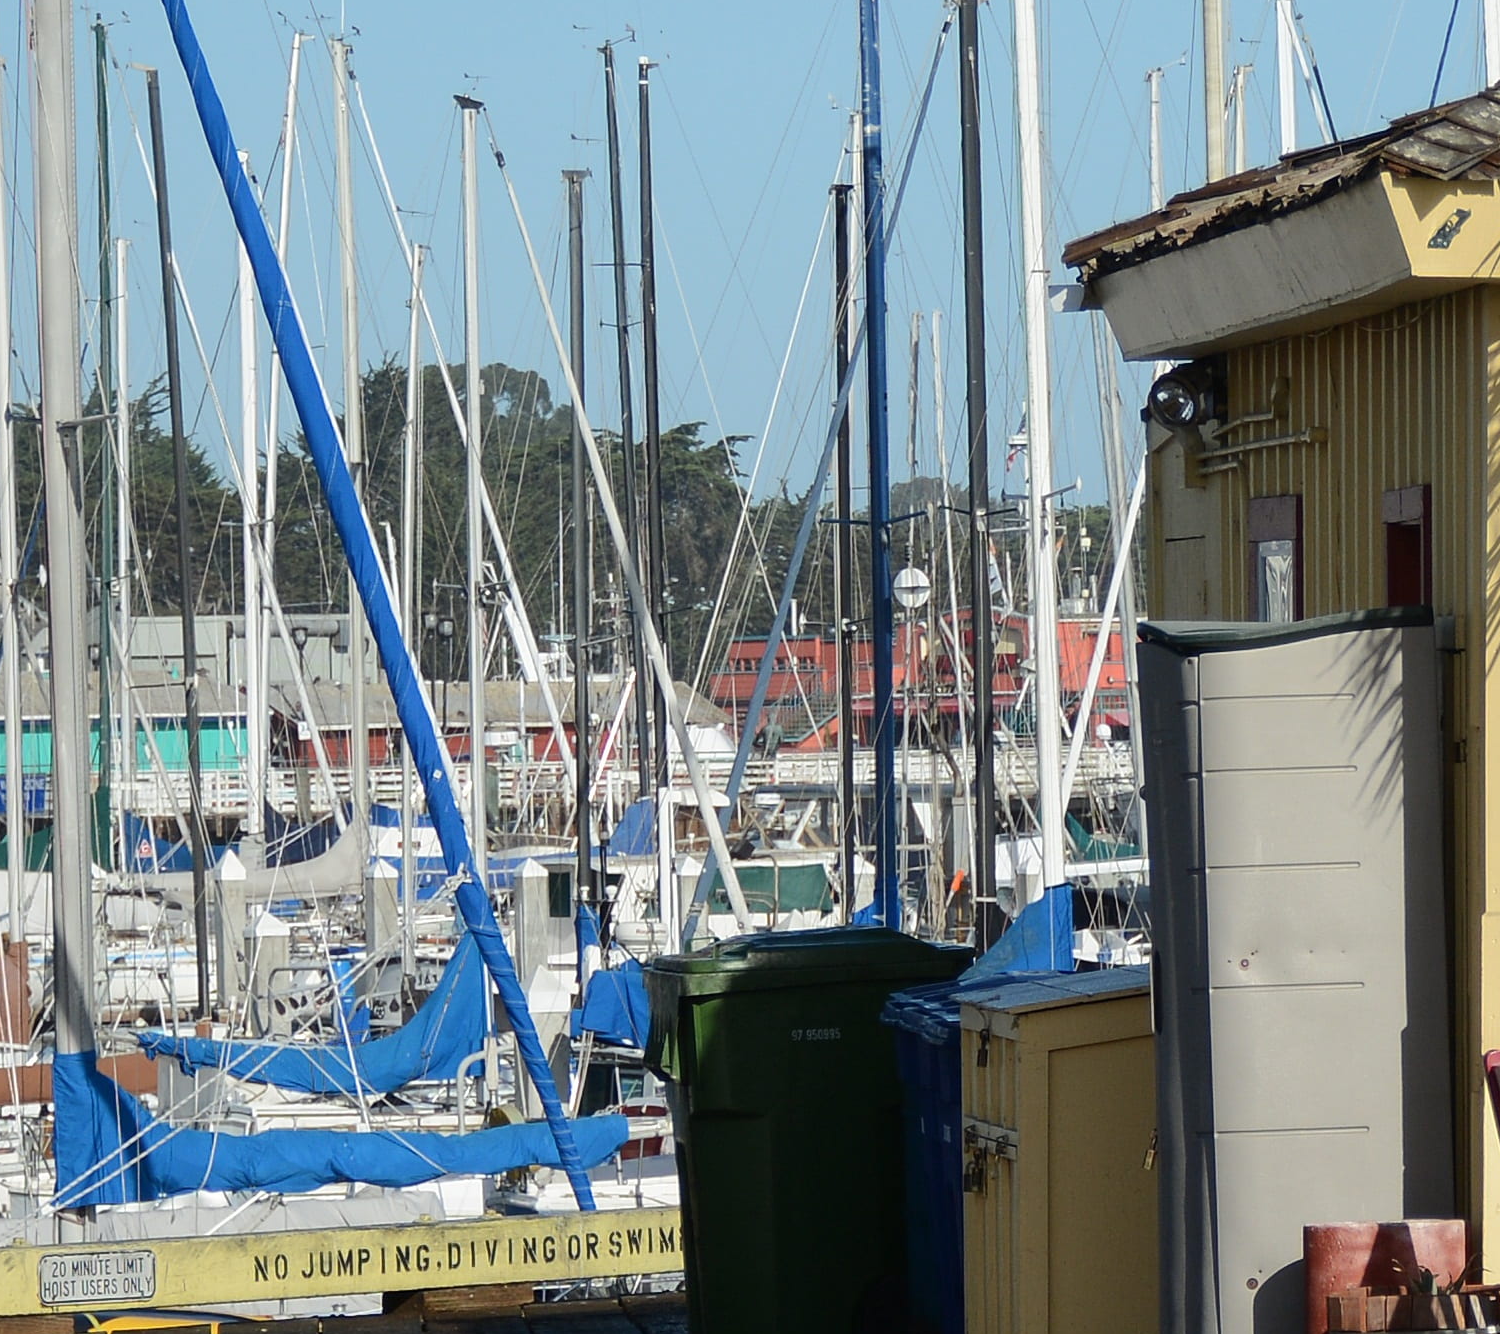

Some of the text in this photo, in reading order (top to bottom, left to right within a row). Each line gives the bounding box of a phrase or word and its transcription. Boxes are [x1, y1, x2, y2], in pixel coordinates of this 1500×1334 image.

[255, 1254, 288, 1282] NO
[567, 1233, 599, 1260] OR
[609, 1225, 683, 1258] SWIM
[52, 1257, 143, 1278] 20 MINUTE LIMIT
[44, 1276, 152, 1298] HOIST USERS ONLY
